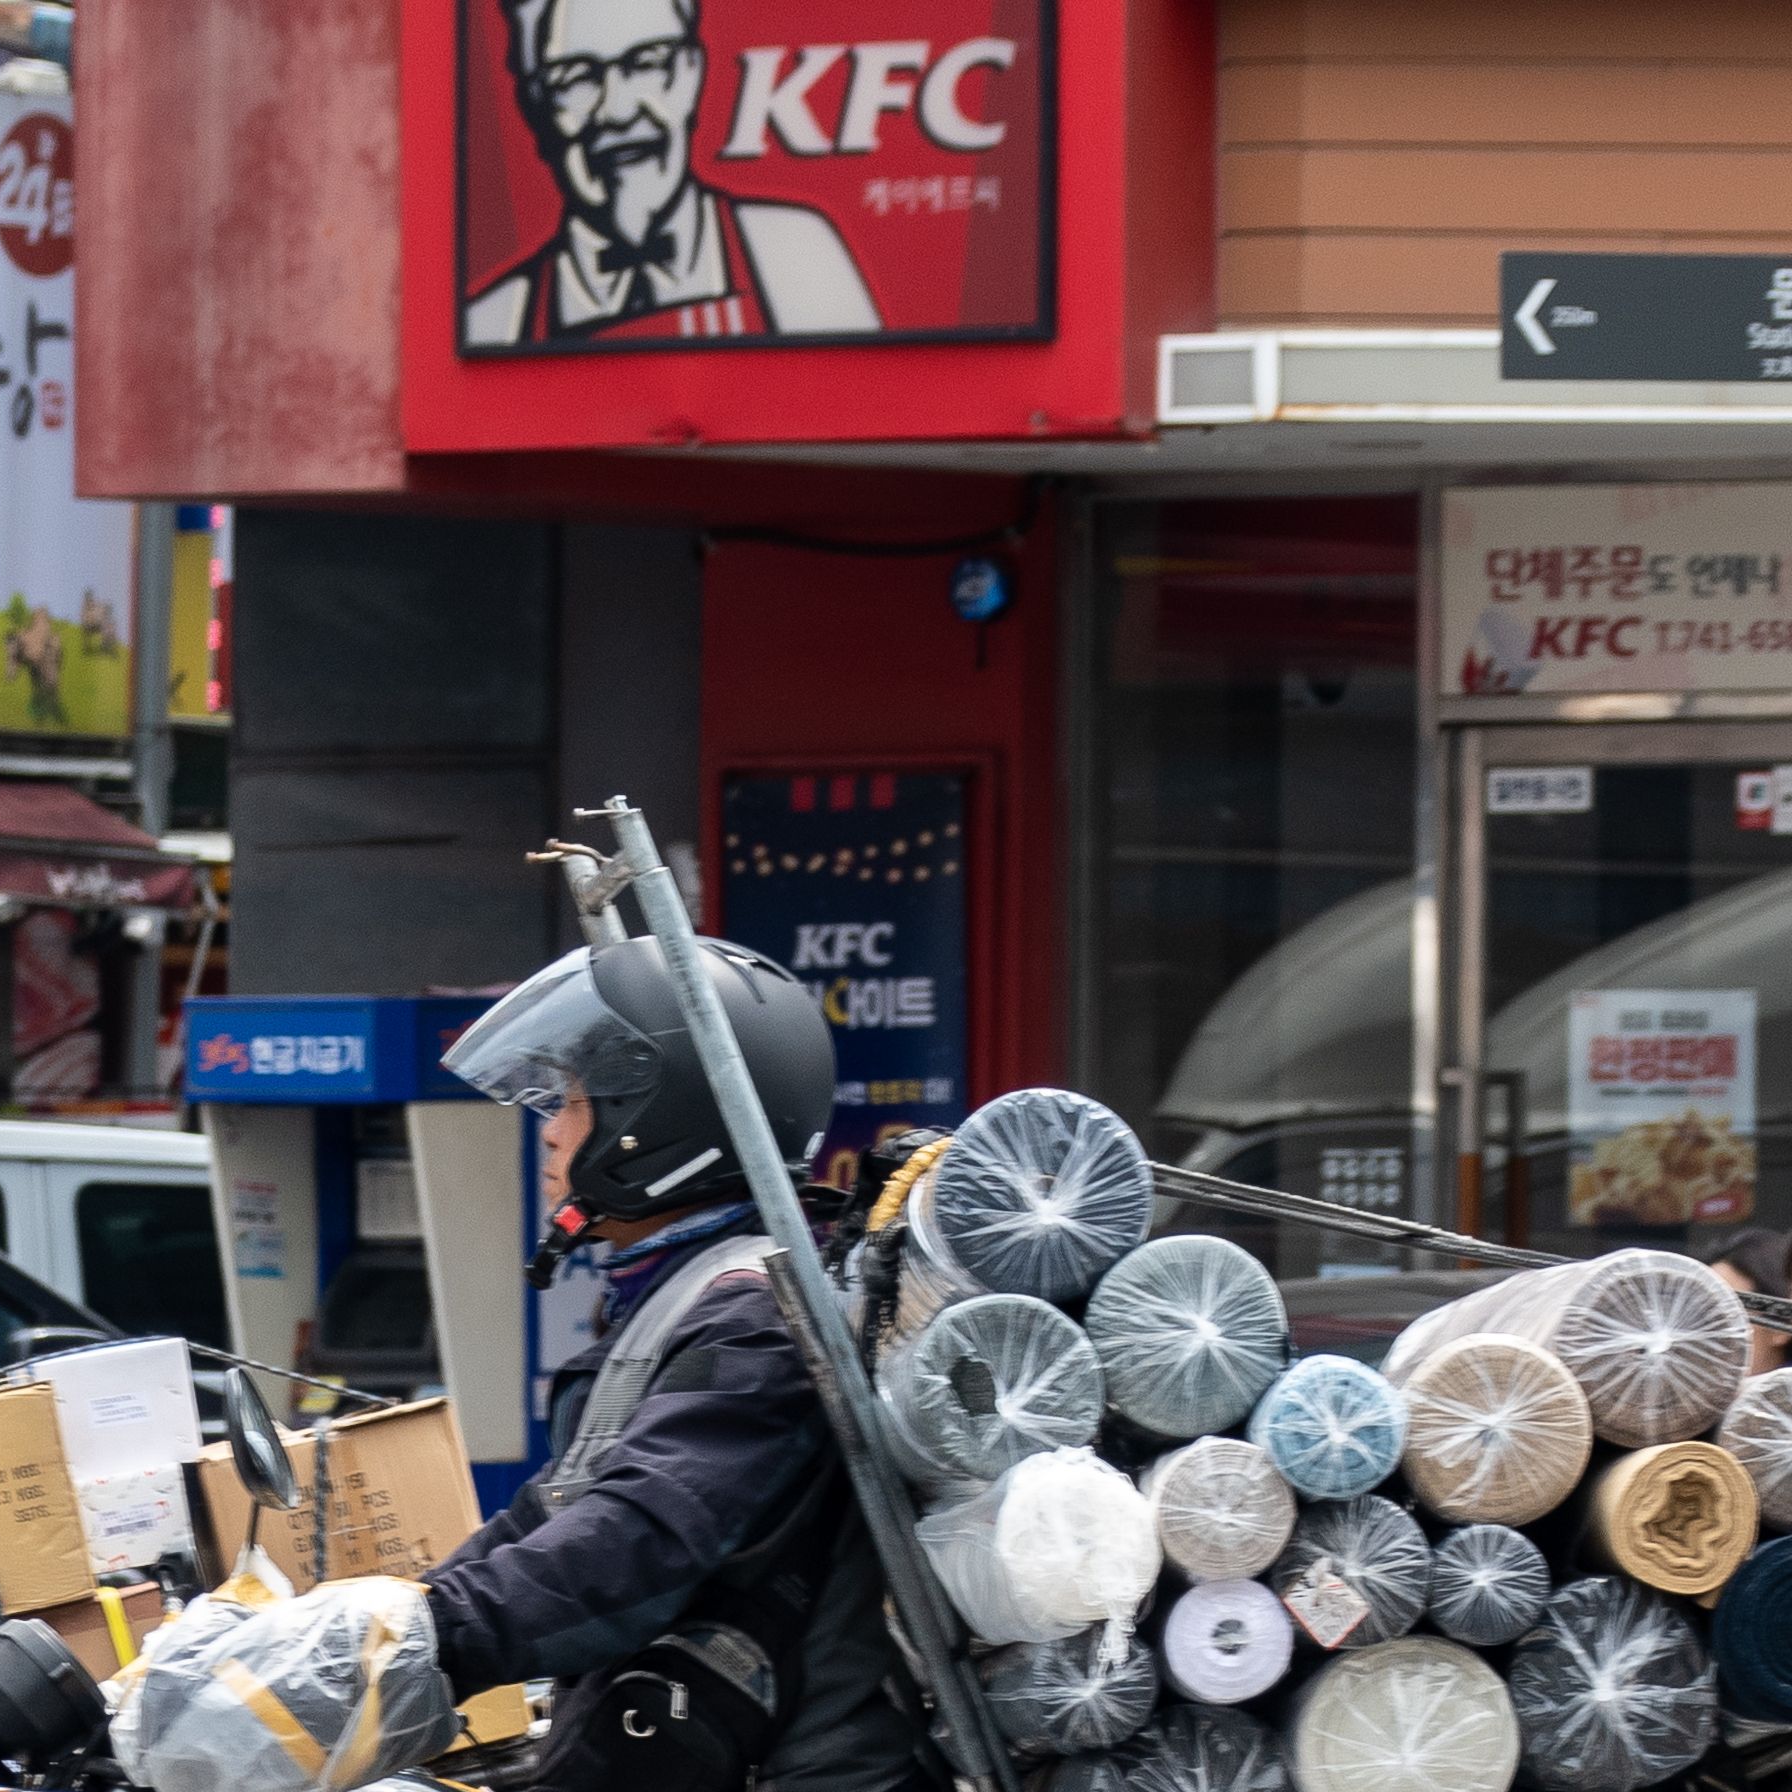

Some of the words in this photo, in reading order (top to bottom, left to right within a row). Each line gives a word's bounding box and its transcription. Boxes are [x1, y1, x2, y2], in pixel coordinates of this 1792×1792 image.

[713, 38, 1016, 160] KFC
[1685, 552, 1783, 599] 언제나
[1529, 613, 1646, 660] KFC
[791, 921, 896, 971] KFC
